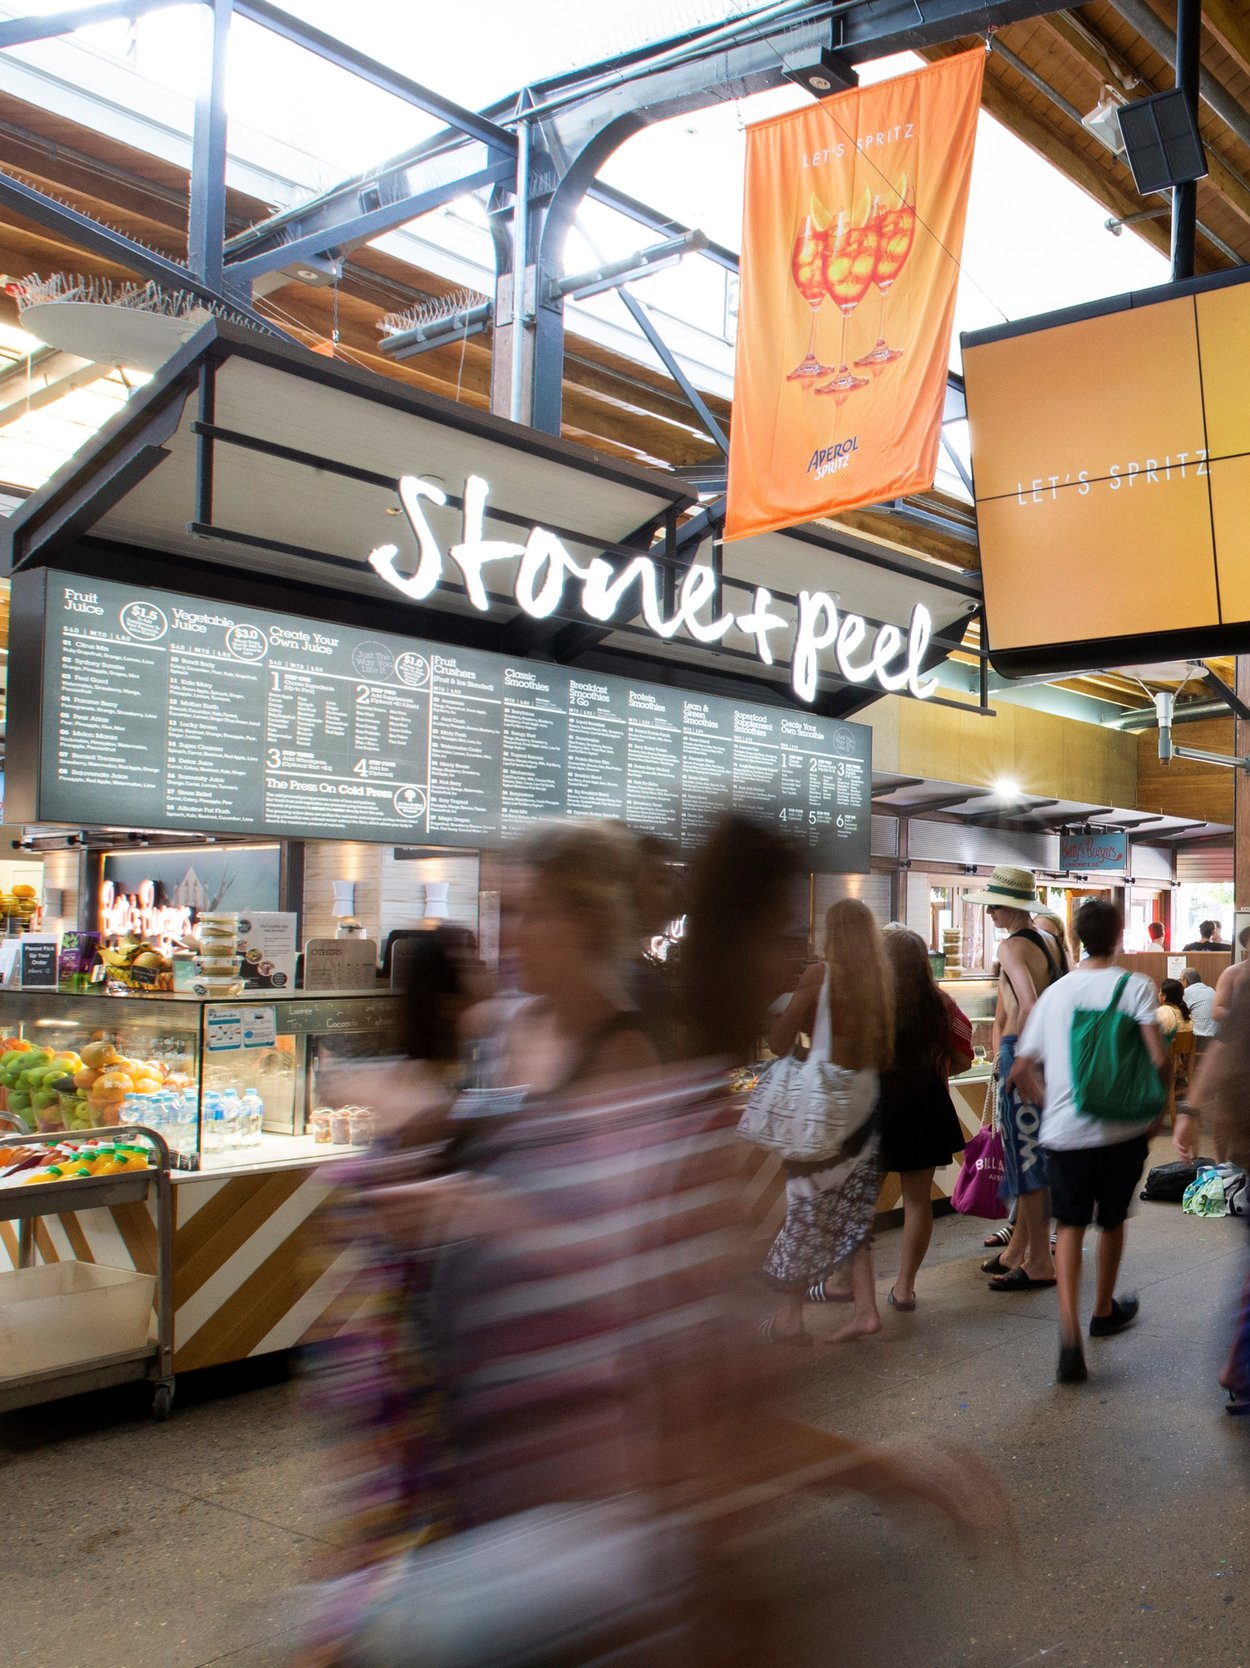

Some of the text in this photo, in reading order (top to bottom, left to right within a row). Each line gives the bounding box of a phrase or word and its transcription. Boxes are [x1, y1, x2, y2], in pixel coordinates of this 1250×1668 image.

[802, 123, 915, 168] LET'S SPRITZ
[806, 435, 860, 473] APEROL
[813, 454, 850, 481] SPRITZ
[1017, 448, 1211, 506] LET'S SPRITZ
[367, 474, 736, 643] Stone
[733, 586, 789, 664] +
[64, 588, 98, 604] Fruit
[64, 599, 104, 616] Juice
[171, 608, 234, 630] Vegetable
[171, 619, 207, 634] Juice
[270, 626, 339, 647] Create Your
[270, 636, 299, 650] Own
[301, 641, 333, 656] Juice
[434, 656, 456, 667] Fruit
[434, 665, 476, 680] Crushers
[505, 668, 536, 681] Classic
[90, 677, 108, 685] Good
[505, 677, 549, 692] Smoothies
[570, 680, 608, 694] Breakfast
[356, 685, 370, 705] 2
[570, 689, 610, 702] Smoothies
[570, 697, 589, 707] 2 Go
[629, 691, 656, 703] Protein
[629, 699, 665, 712] Smoothies
[684, 701, 702, 711] Lean
[683, 716, 718, 728] Smoothies
[734, 711, 766, 723] Superfood
[734, 718, 772, 731] Supplement
[781, 719, 816, 732] Create Your
[781, 727, 824, 740] Own Smoothie
[267, 748, 281, 769] 3
[810, 758, 817, 772] 2
[353, 758, 368, 778] 4
[838, 763, 844, 776] 3
[266, 778, 393, 799] The Press On Cold Press
[779, 808, 787, 821] 4
[809, 811, 816, 825] 5
[836, 814, 843, 827] 6
